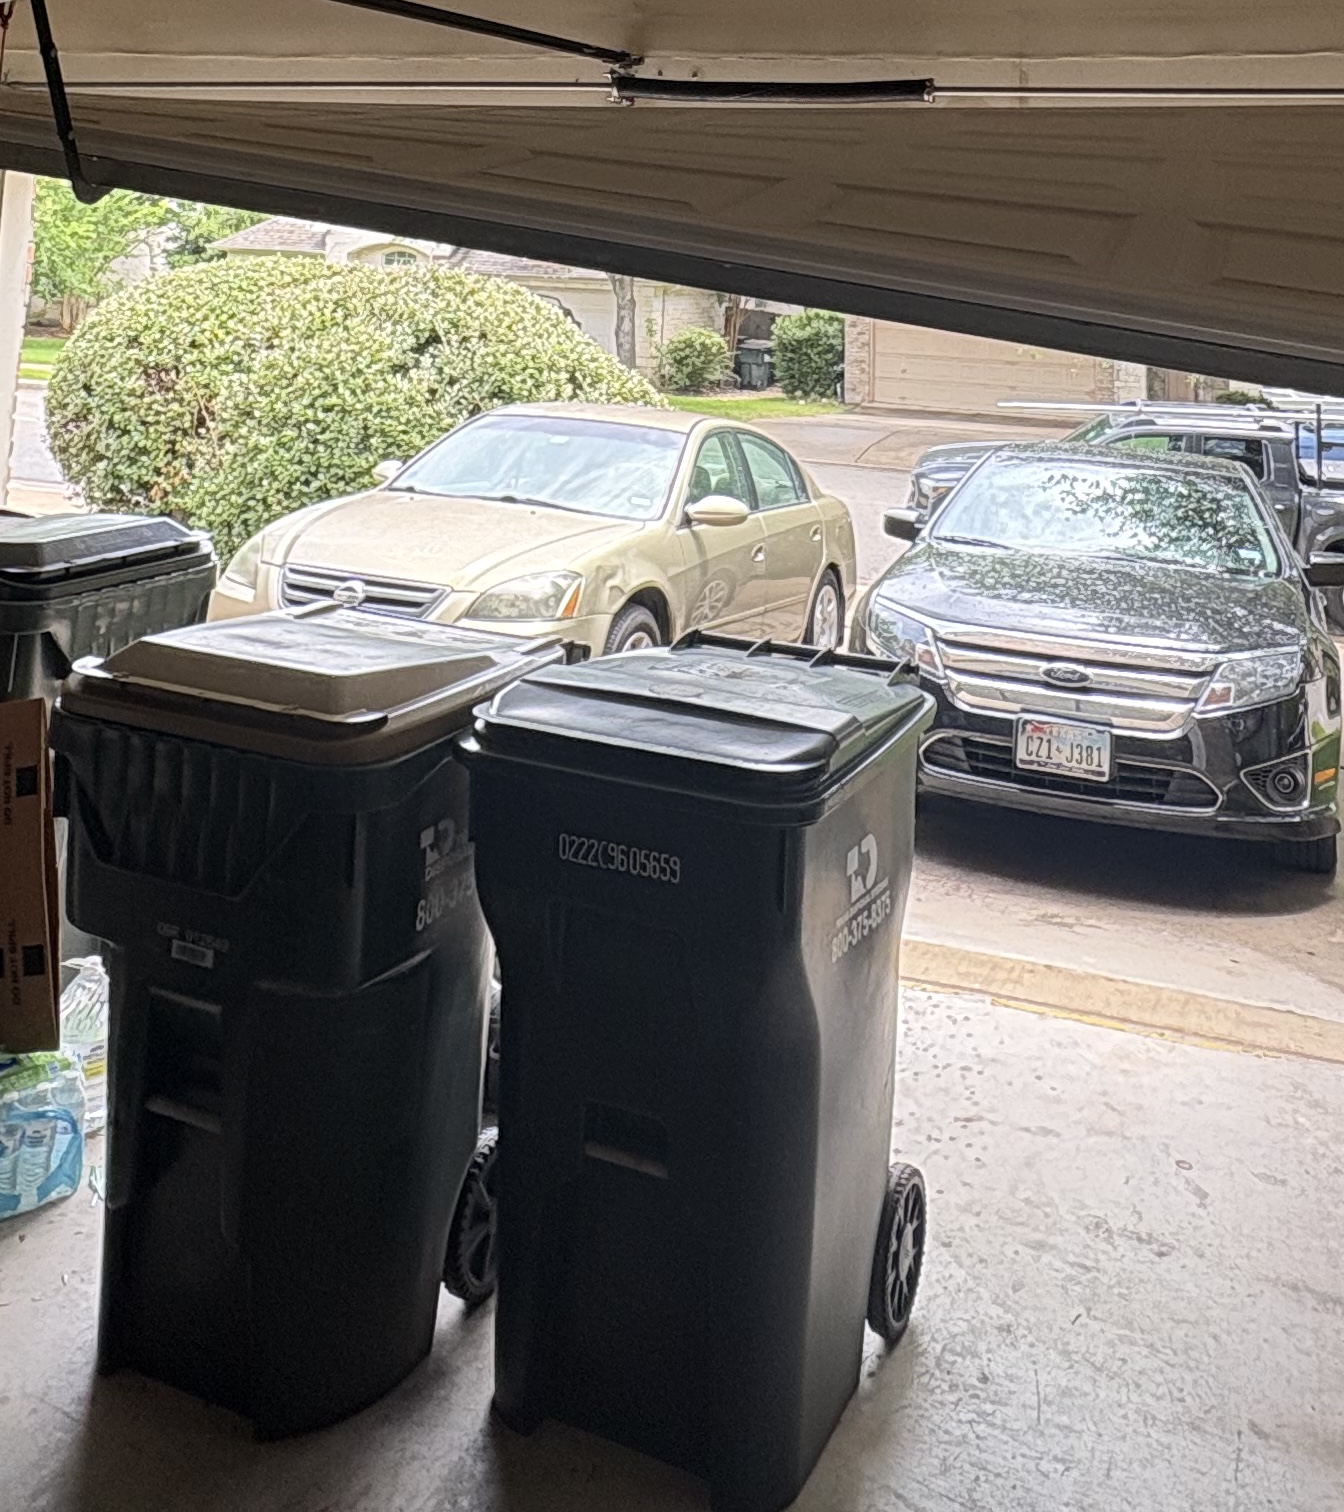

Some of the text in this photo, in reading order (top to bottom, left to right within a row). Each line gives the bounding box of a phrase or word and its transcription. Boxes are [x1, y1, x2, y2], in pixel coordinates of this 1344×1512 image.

[1050, 667, 1080, 681] Ford
[558, 833, 681, 884] 0222C9605659
[831, 889, 891, 964] 800-375-8375
